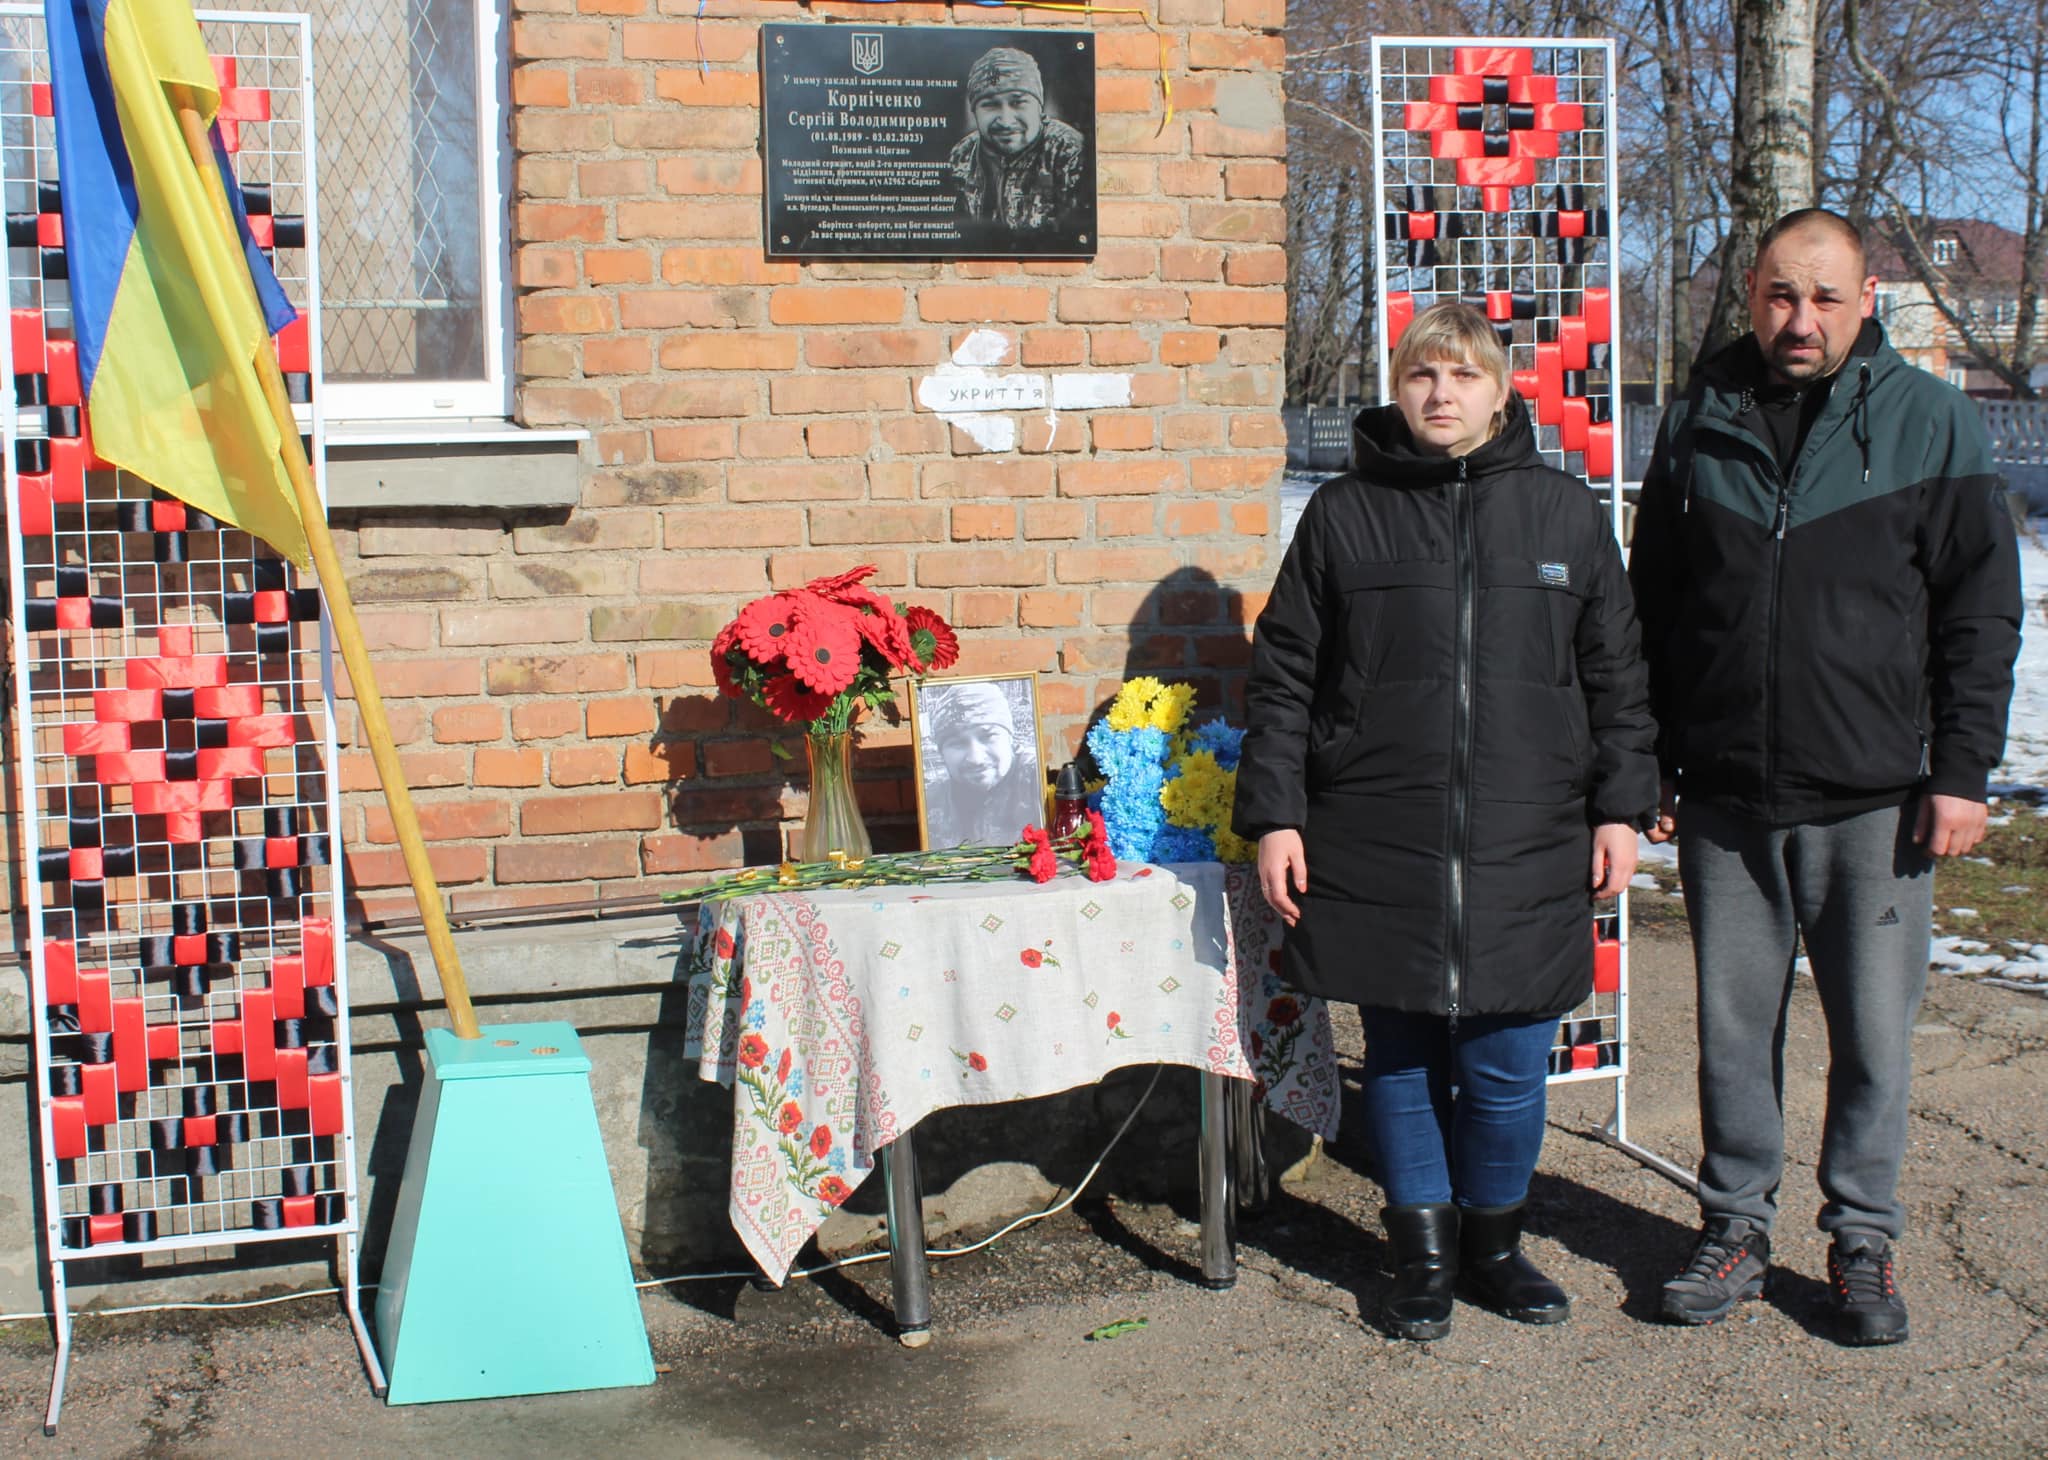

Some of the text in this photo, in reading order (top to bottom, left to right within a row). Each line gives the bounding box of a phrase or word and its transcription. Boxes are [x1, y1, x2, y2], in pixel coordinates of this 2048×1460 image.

[824, 76, 858, 86] закладі
[926, 80, 958, 88] земляк
[828, 89, 921, 111] Корніченко
[788, 111, 947, 130] Сергій Володимирович
[831, 145, 873, 154] Позивний
[950, 387, 1043, 401] УКРИТТЯ
